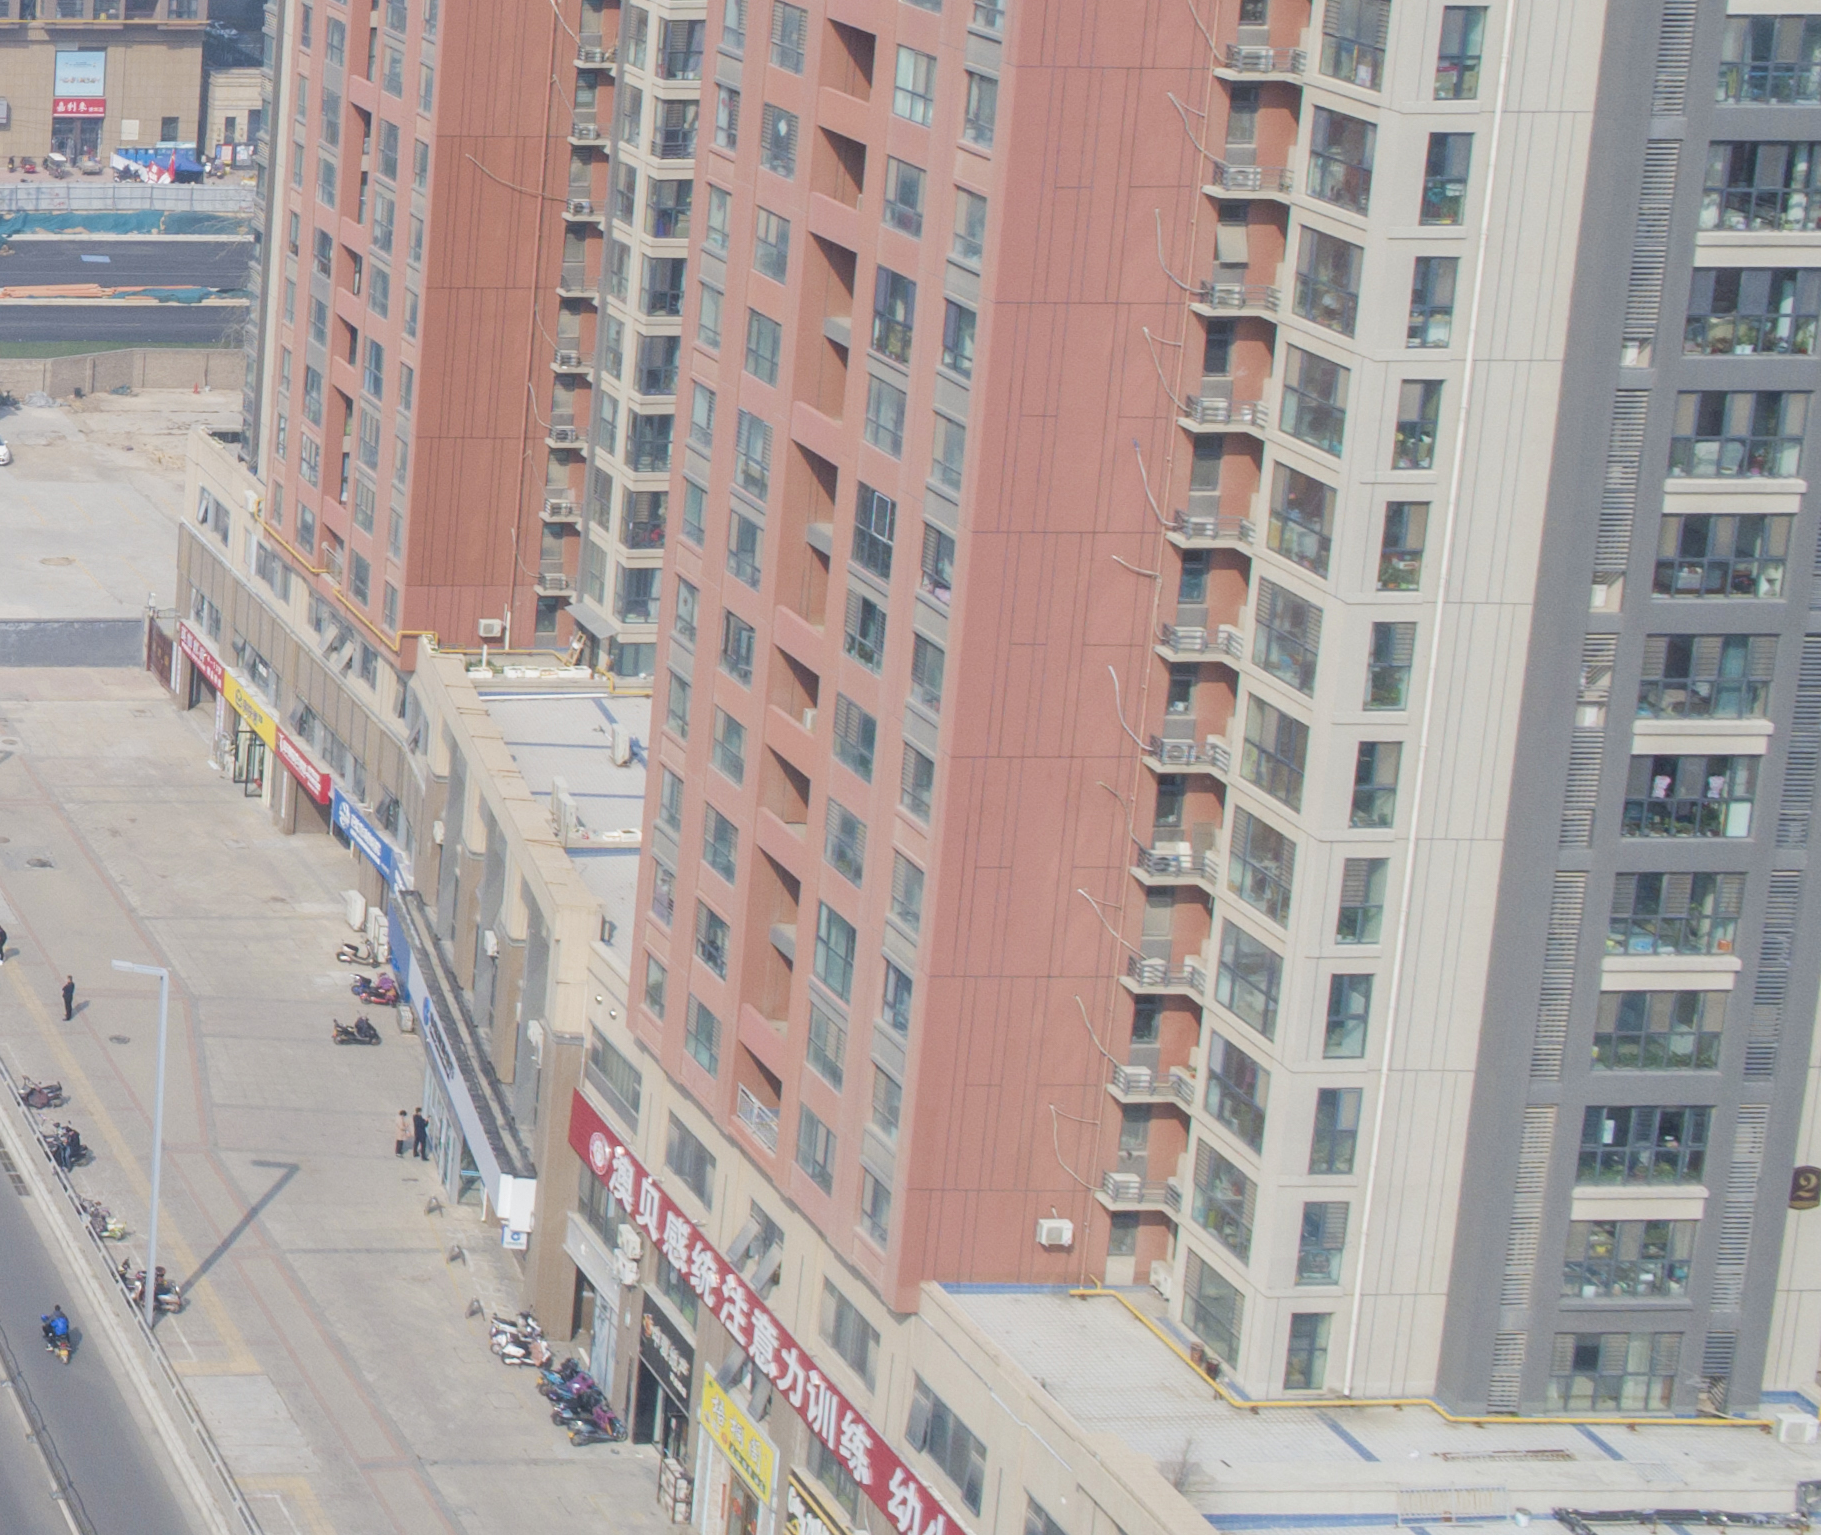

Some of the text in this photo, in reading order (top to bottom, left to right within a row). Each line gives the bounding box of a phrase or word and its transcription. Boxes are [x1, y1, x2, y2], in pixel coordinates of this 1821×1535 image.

[608, 1150, 874, 1486] 澳贝感统注意力训练
